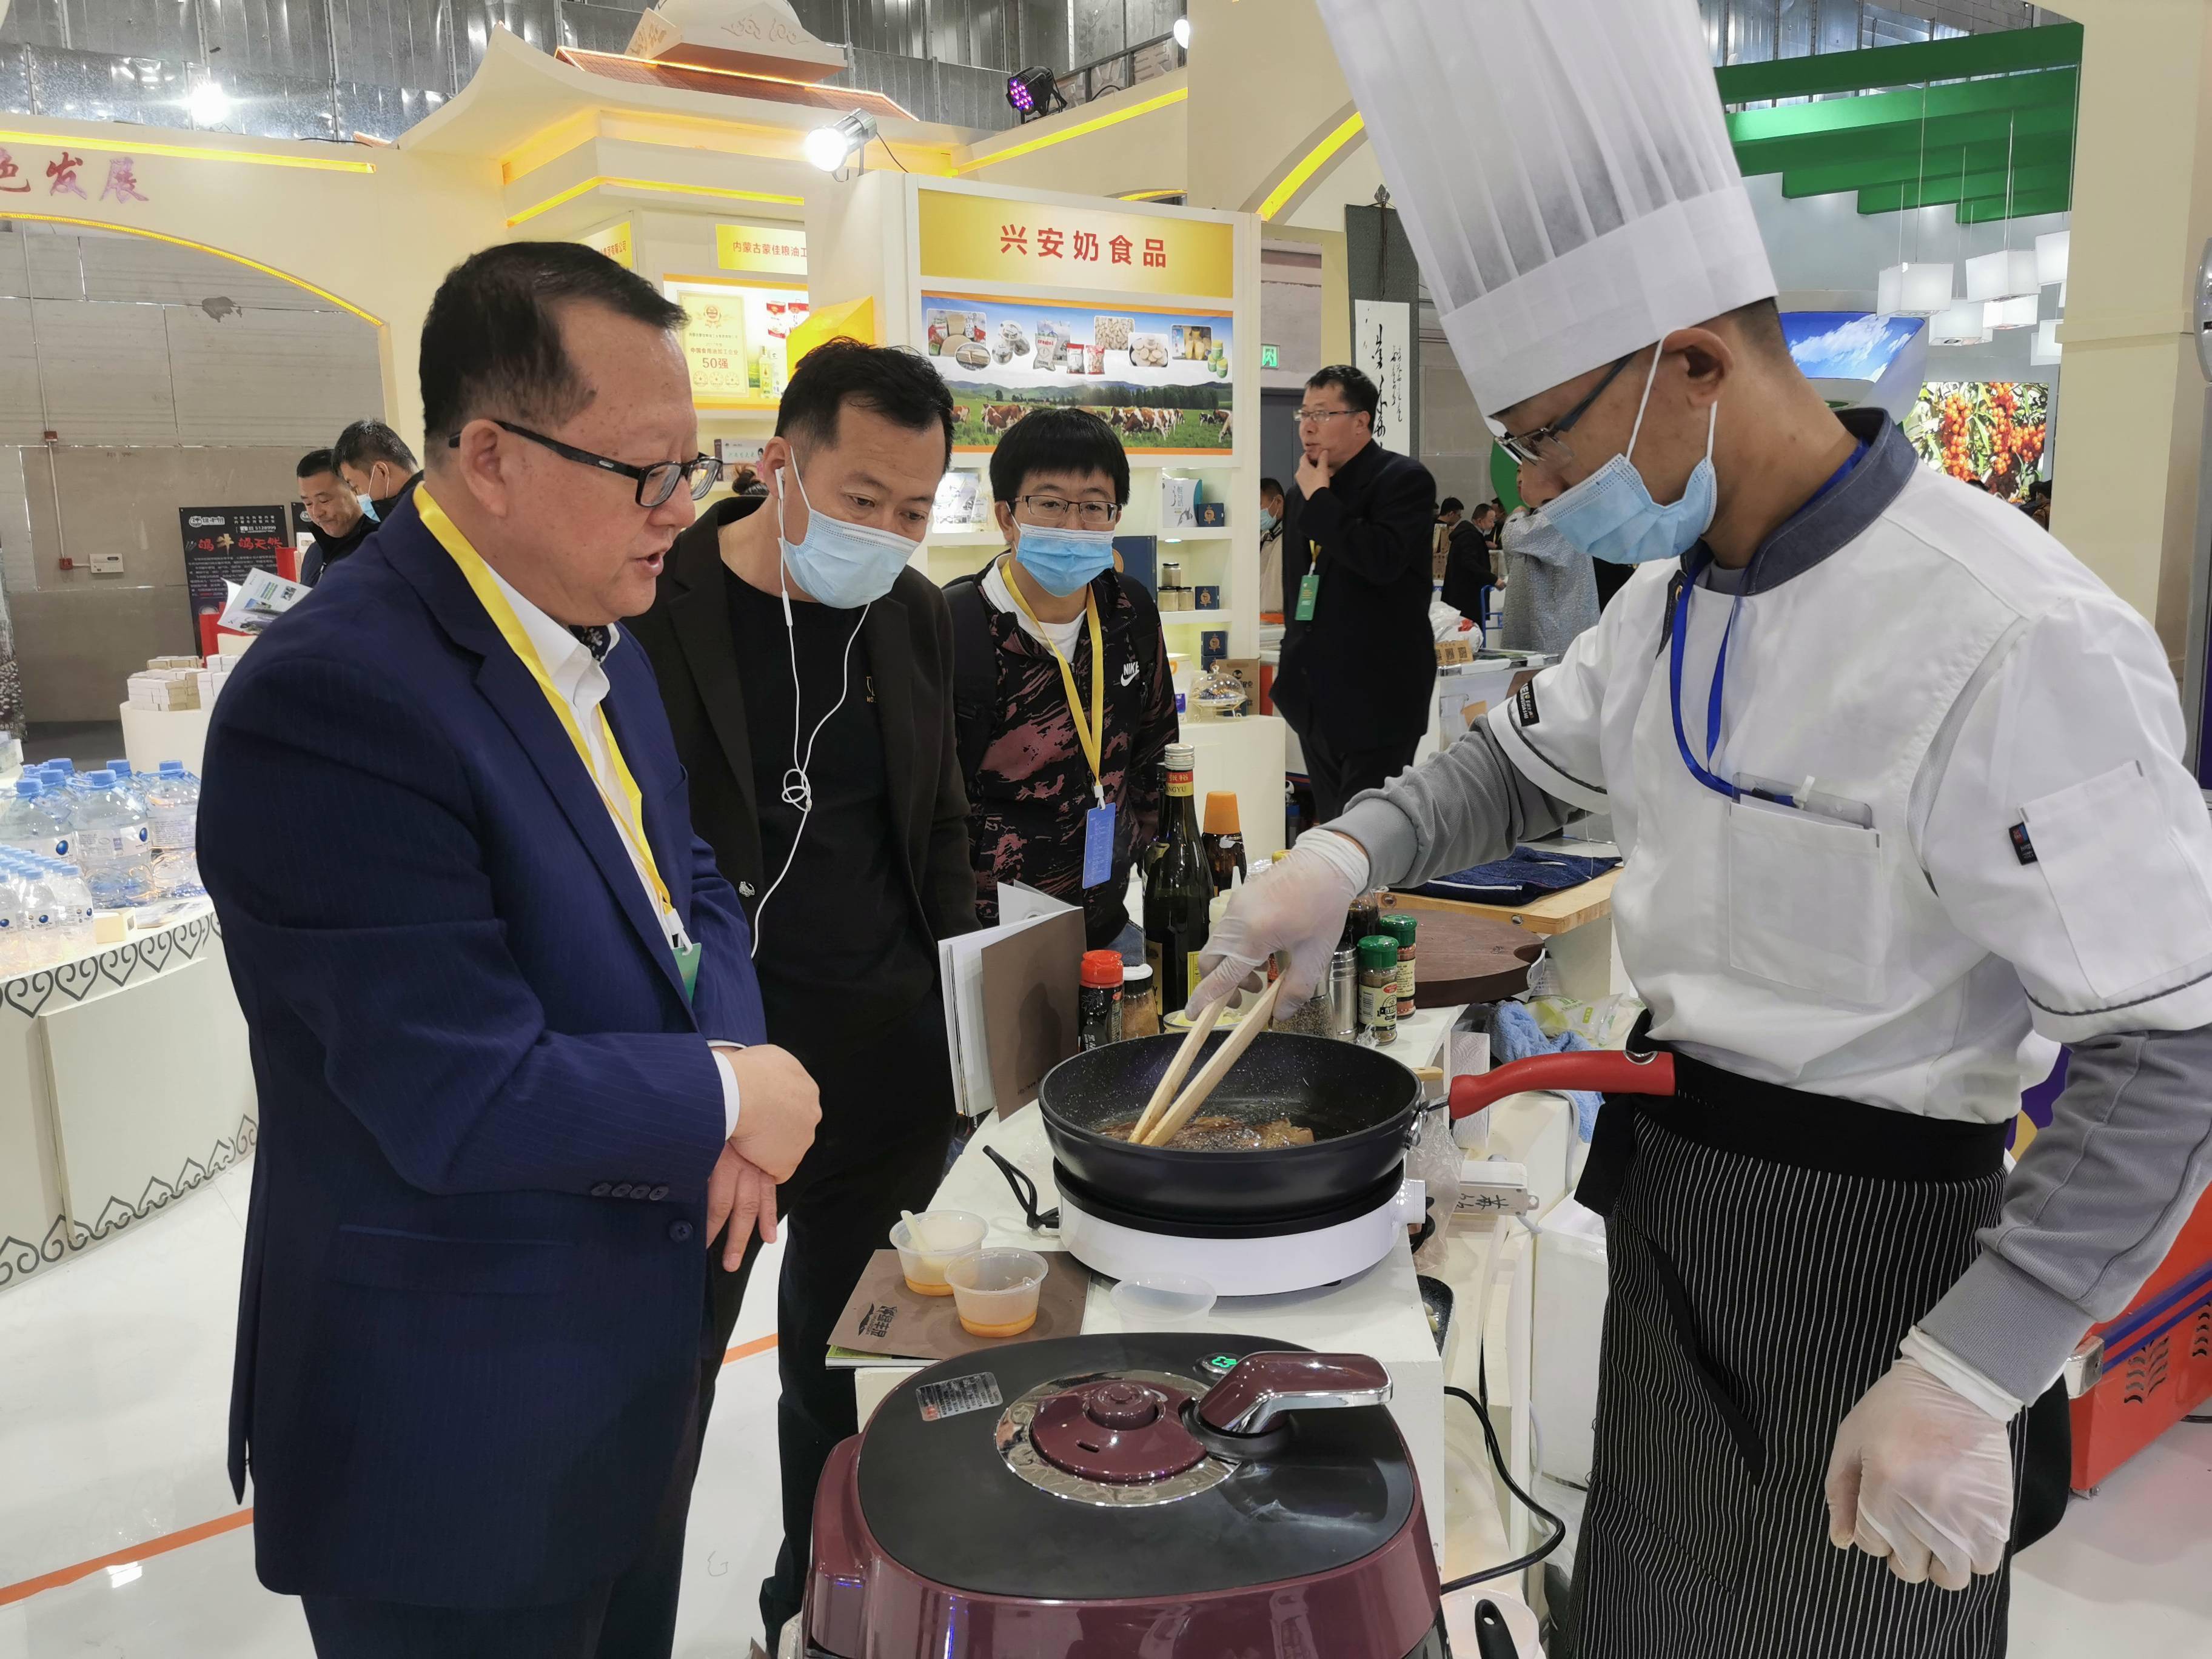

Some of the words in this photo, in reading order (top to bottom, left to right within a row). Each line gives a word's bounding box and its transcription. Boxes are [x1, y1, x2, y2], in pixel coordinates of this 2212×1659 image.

[732, 241, 807, 257] 内蒙古蒙佳粮油工
[1000, 224, 1166, 267] 兴安奶食品
[702, 357, 728, 369] 50强
[1124, 661, 1140, 675] NIKE
